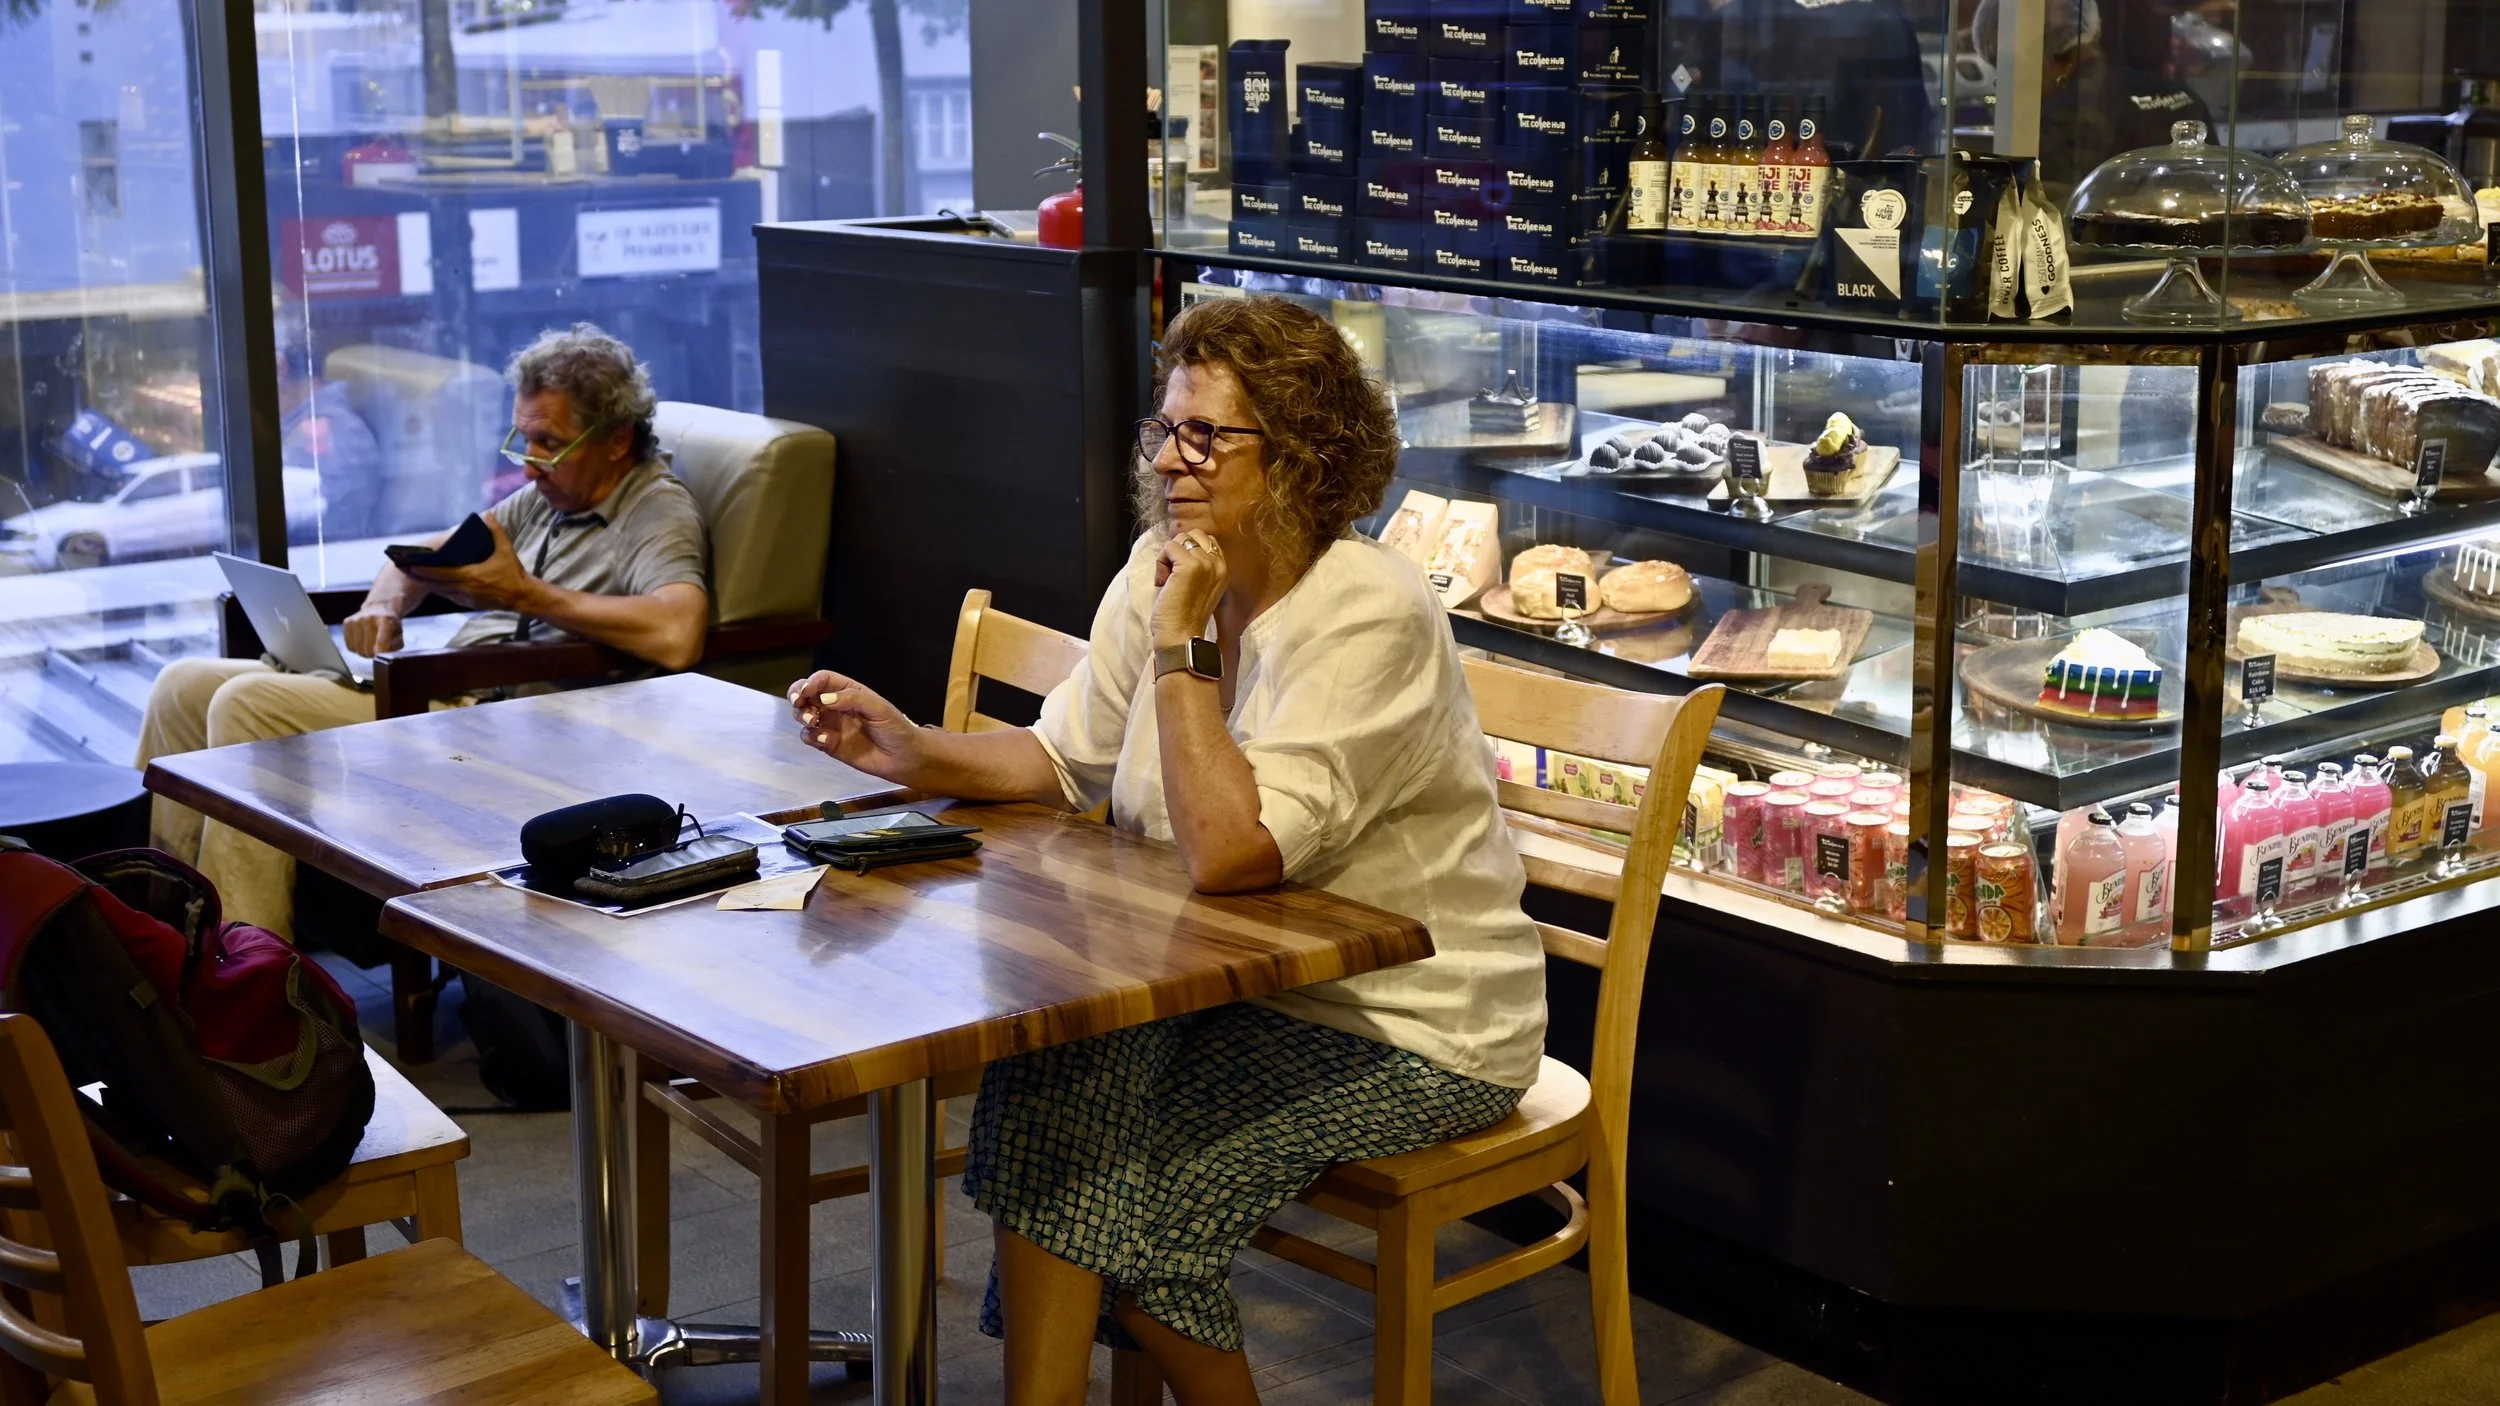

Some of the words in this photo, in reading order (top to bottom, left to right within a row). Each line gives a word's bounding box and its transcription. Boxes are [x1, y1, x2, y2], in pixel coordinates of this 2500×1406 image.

[304, 245, 379, 272] LOTUS
[1994, 233, 2010, 273] COFFEE
[2032, 218, 2056, 281] GOODNESS
[1837, 283, 1876, 298] BLACK
